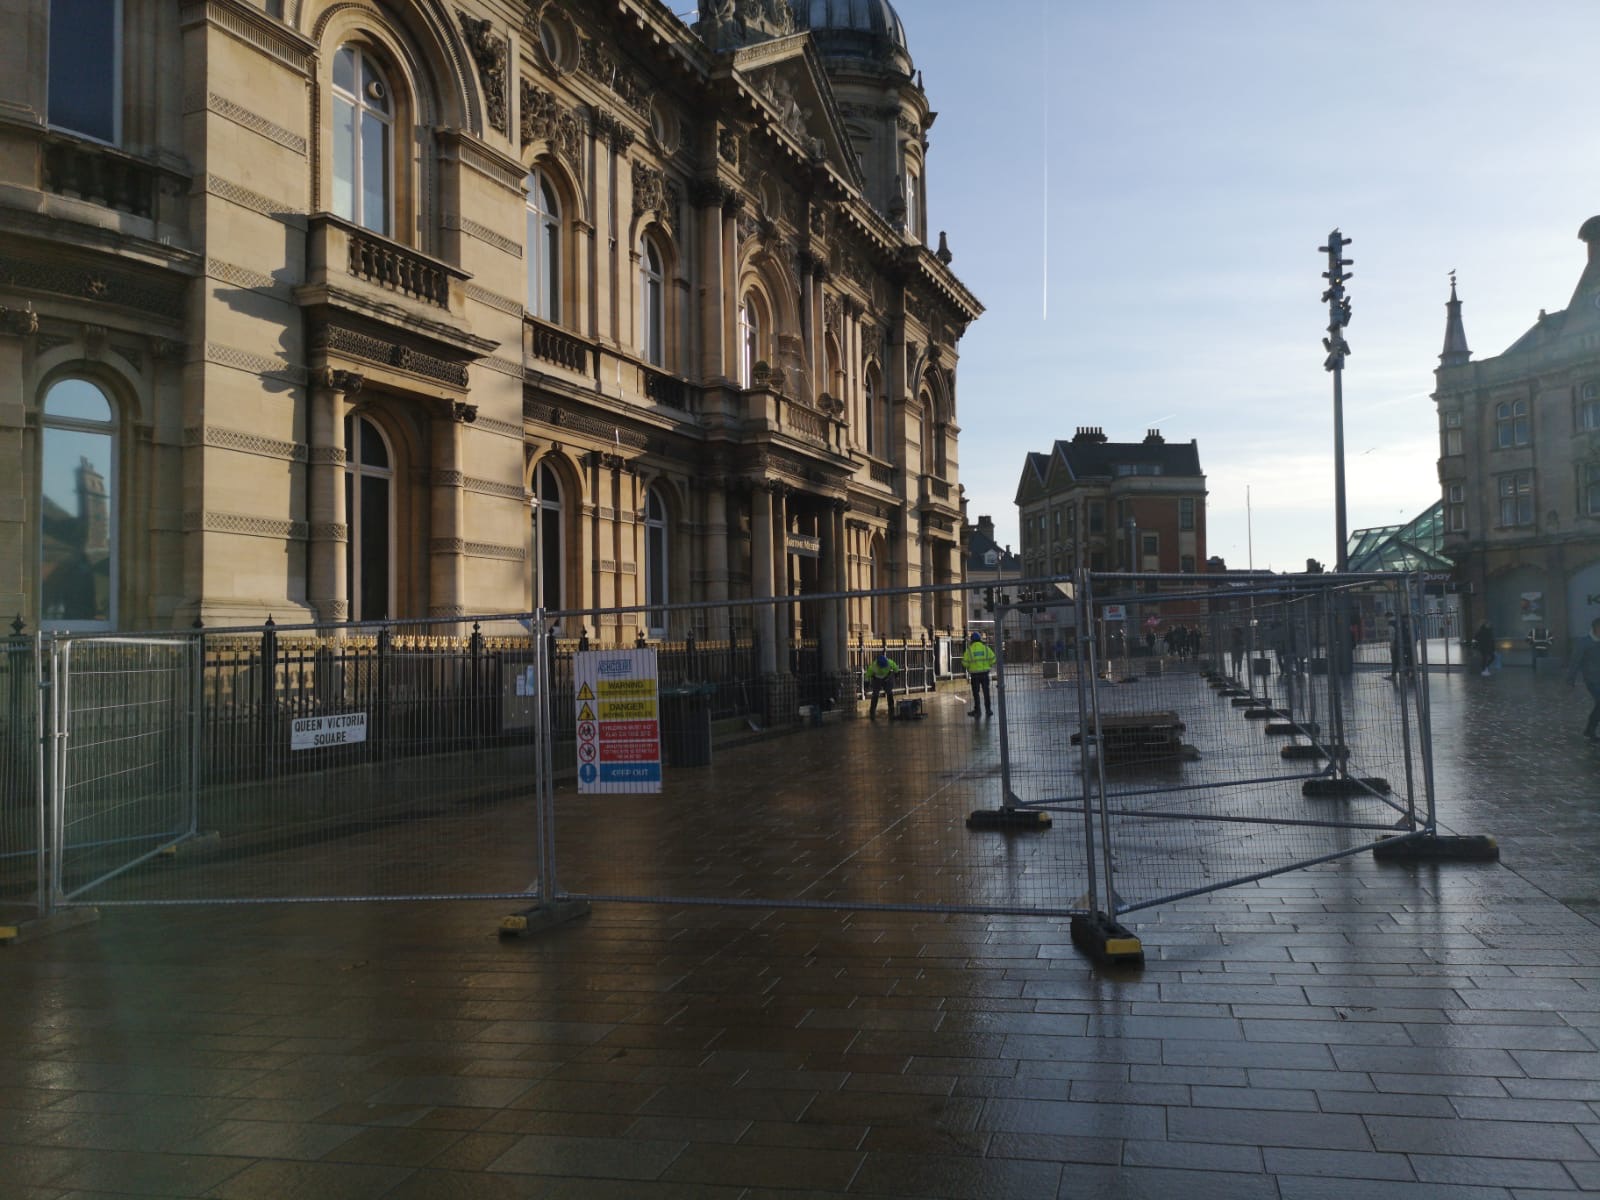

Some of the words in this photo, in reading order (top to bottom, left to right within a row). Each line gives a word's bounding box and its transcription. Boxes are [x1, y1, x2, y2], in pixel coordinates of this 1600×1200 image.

[608, 681, 644, 689] WARNING
[609, 703, 644, 711] DANGER
[294, 719, 323, 733] QUEEN
[327, 714, 365, 729] VICTORIA
[313, 731, 347, 746] SQUARE
[611, 768, 631, 777] KEEP
[632, 768, 649, 776] OUT
